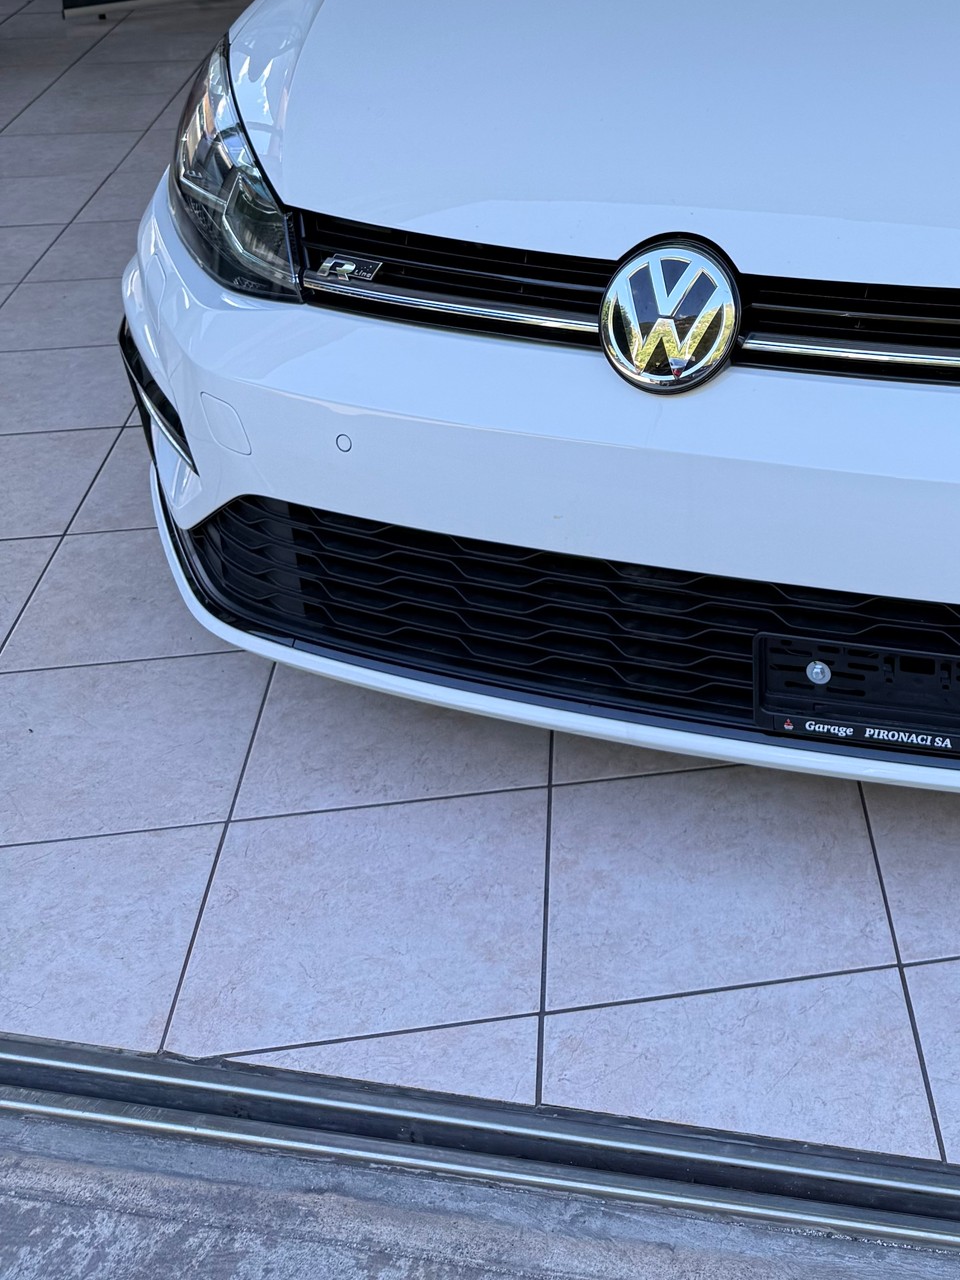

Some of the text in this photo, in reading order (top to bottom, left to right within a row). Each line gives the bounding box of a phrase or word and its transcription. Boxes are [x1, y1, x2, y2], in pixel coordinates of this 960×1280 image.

[316, 257, 356, 281] R
[805, 721, 853, 737] Garage
[864, 727, 932, 746] PIRONACI
[934, 735, 952, 748] SA
